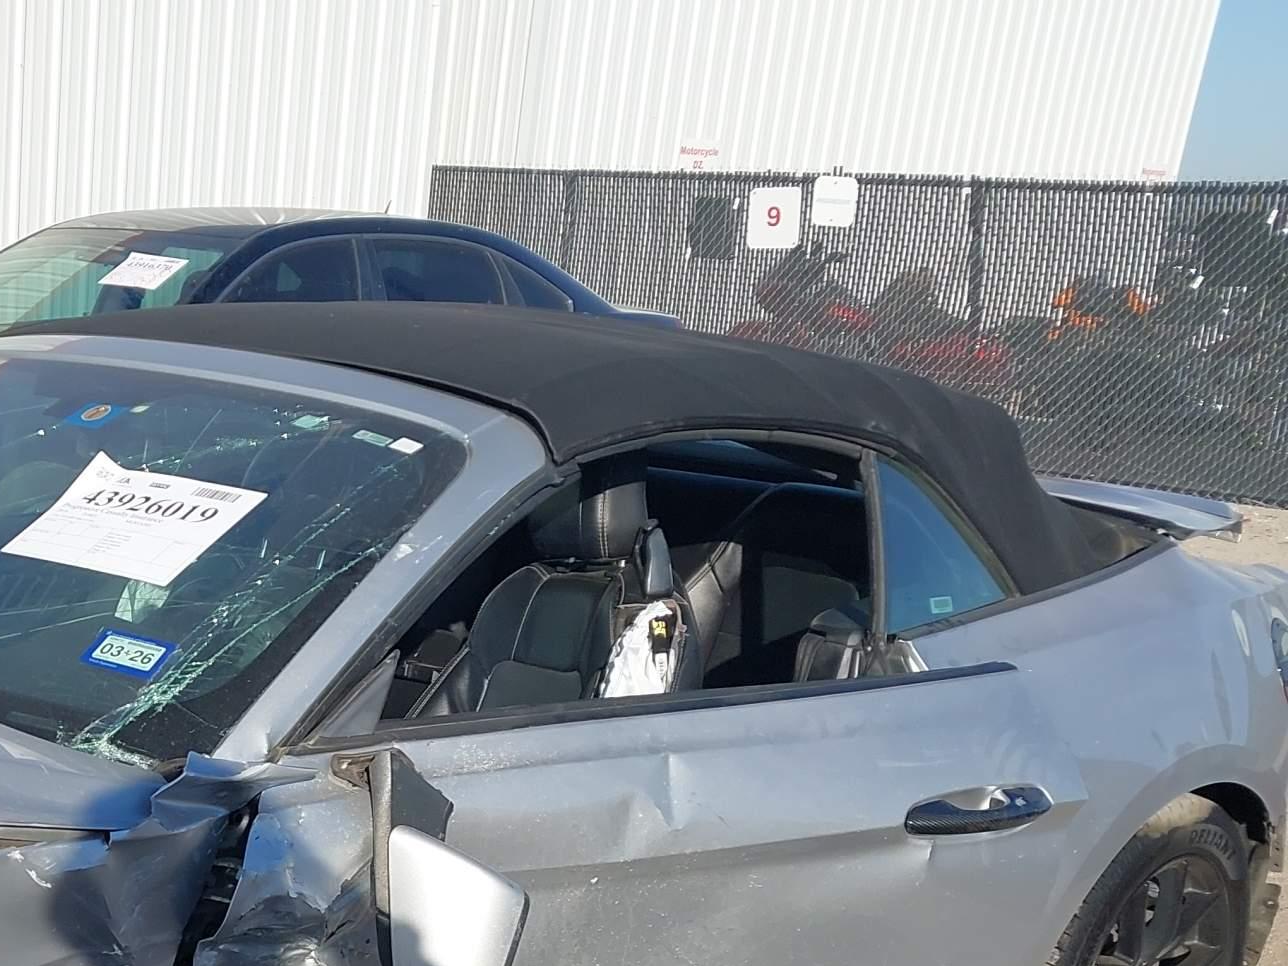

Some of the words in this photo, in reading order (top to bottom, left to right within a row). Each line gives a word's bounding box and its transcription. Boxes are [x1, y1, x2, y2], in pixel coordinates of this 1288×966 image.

[680, 145, 719, 158] Motorcycle
[767, 206, 781, 227] 9
[82, 488, 220, 523] 43926019
